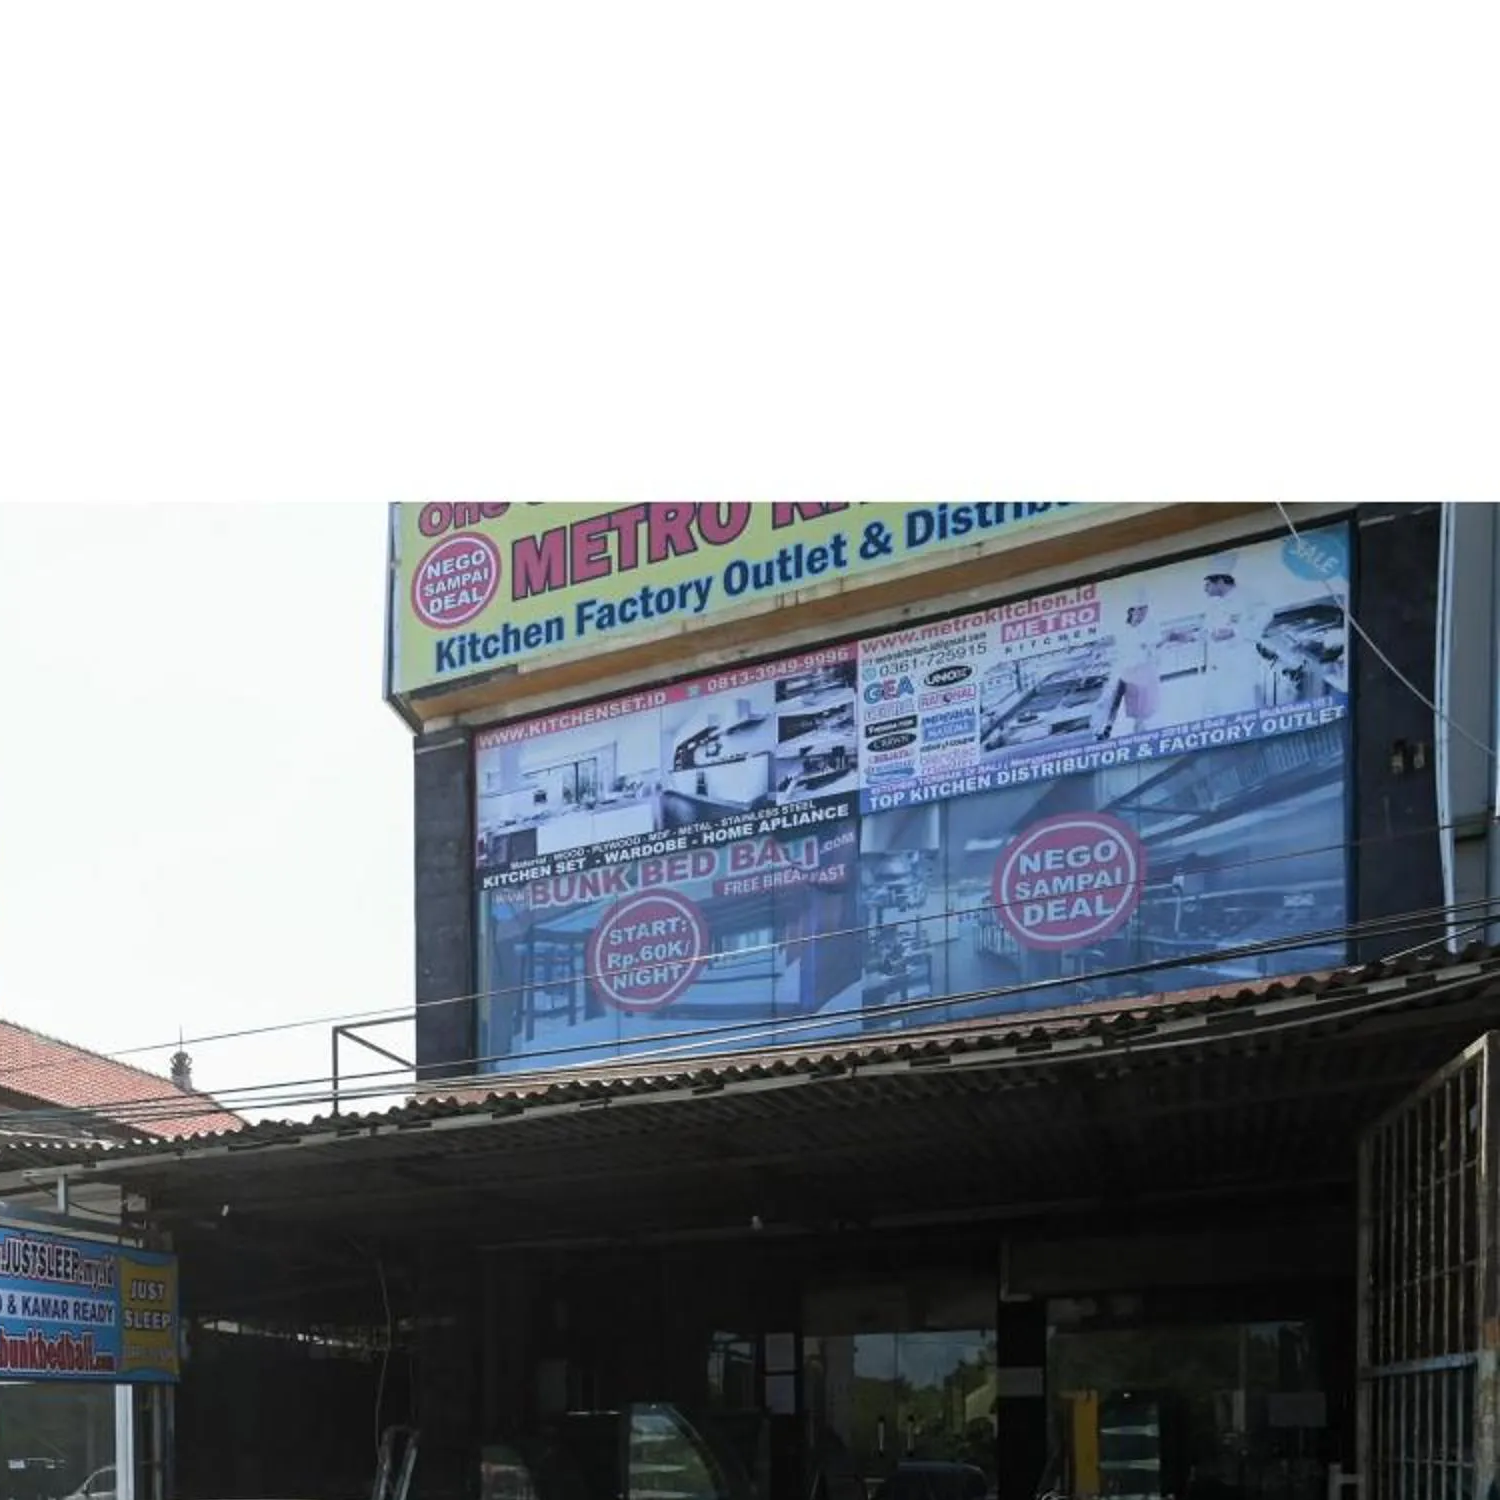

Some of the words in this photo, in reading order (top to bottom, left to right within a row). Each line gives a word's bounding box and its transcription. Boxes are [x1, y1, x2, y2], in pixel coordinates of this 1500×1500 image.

[426, 548, 486, 581] NEGO
[511, 501, 751, 602] METRO
[423, 567, 490, 598] SAMPAI
[435, 614, 565, 673] Kitchen
[575, 574, 713, 637] Factory
[723, 532, 847, 597] Outlet
[859, 520, 893, 561] &
[429, 586, 485, 615] DEAL
[861, 584, 1097, 653] www.metrokitchen.id
[1004, 607, 1097, 642] METRO
[864, 675, 914, 704] GEA
[479, 690, 667, 750] WWW.KITCHENSET.ID
[869, 791, 904, 811] TOP
[910, 774, 991, 803] KITCHEN
[997, 747, 1130, 785] DISTRIBUTOR
[1137, 743, 1153, 757] &
[1159, 722, 1256, 754] FACTORY
[1262, 706, 1344, 732] OUTLET
[483, 865, 552, 889] KITCHEN
[555, 857, 587, 874] SET
[604, 837, 688, 865] WARDOBE
[702, 821, 753, 846] HOME
[758, 803, 850, 833] APLIANCE
[1019, 839, 1118, 874] NEGO
[530, 860, 634, 910] BUNK
[639, 847, 719, 890] BED
[723, 876, 760, 896] FREE
[1015, 867, 1122, 900] SAMPAI
[1023, 895, 1115, 927] DEAL
[613, 964, 683, 991] NIGHT
[131, 1279, 164, 1300] JUST
[7, 1293, 17, 1314] &
[21, 1295, 69, 1319] KAMAR
[73, 1300, 115, 1325] READY
[124, 1309, 171, 1329] SLEEP
